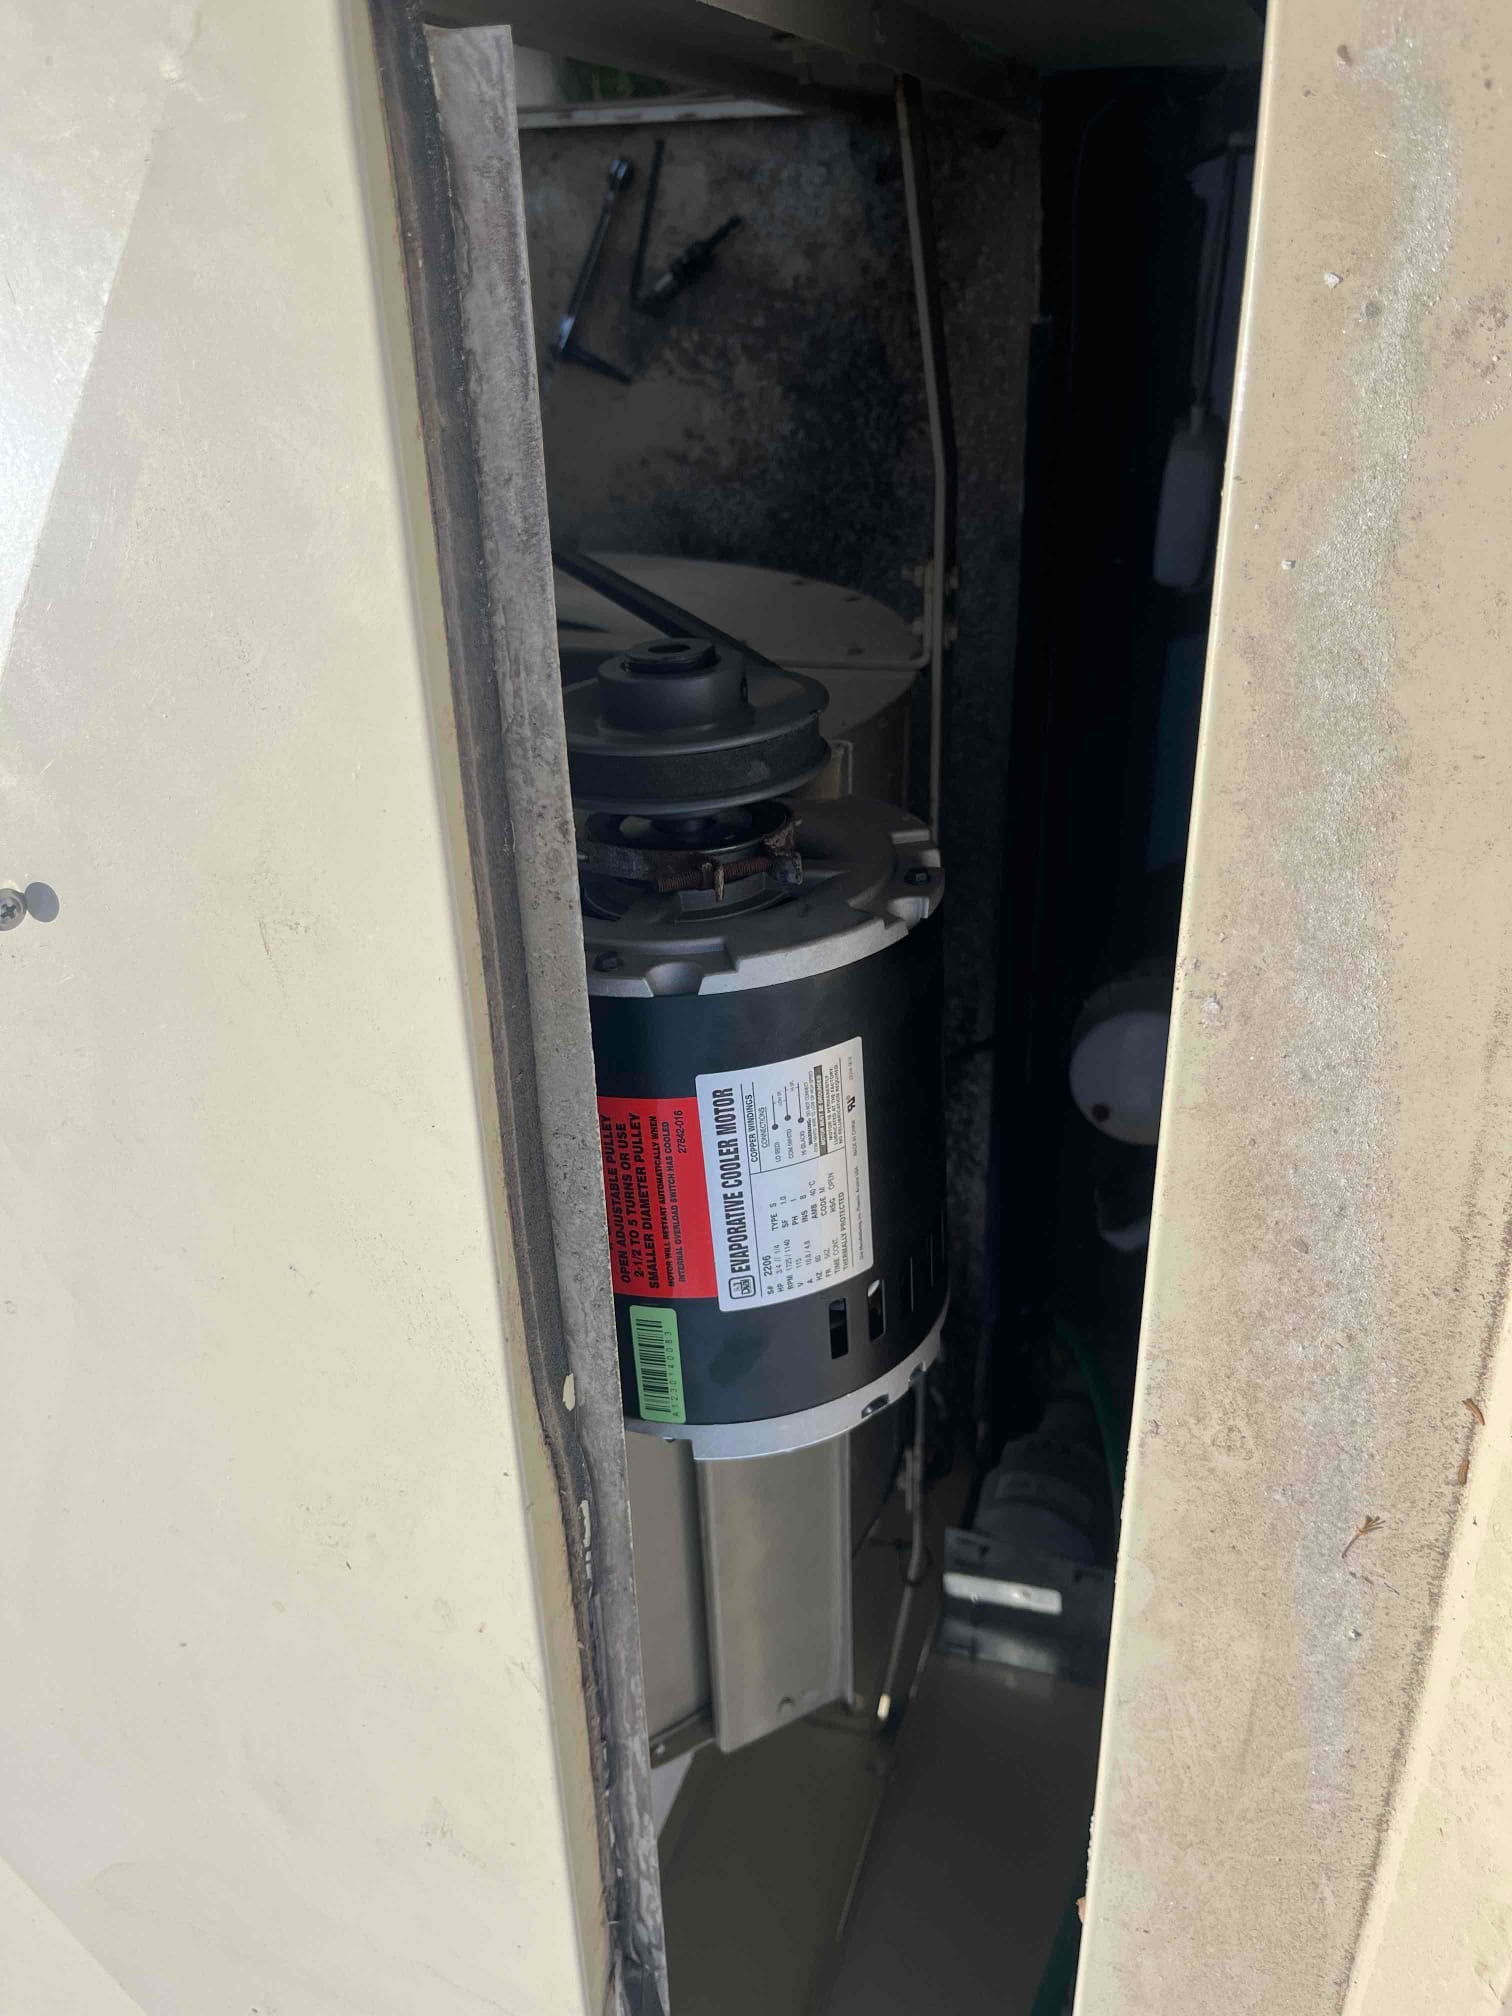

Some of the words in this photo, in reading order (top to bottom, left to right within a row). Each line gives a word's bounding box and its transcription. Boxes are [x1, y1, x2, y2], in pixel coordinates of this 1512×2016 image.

[712, 1088, 736, 1136] MOTOR
[745, 1094, 755, 1131] WINDINGS
[599, 1115, 616, 1163] PULLEY
[616, 1124, 628, 1148] USE
[629, 1113, 644, 1162] PULLEY
[648, 1116, 658, 1139] WHEN
[662, 1122, 672, 1153] COOLED
[758, 1107, 768, 1148] CONNECTIONS
[620, 1153, 631, 1170] OR
[749, 1134, 758, 1162] COPPER
[652, 1142, 665, 1204] AUTOMATICALLY
[666, 1156, 674, 1172] HAS
[718, 1139, 742, 1188] COOLER
[622, 1174, 636, 1215] TURNS
[636, 1167, 652, 1230] DIAMETER
[668, 1174, 677, 1202] SWITCH
[608, 1168, 626, 1248] ADJUSTABLE
[770, 1213, 778, 1231] TYPE
[792, 1216, 798, 1225] PH
[810, 1204, 818, 1218] AMB
[838, 1192, 846, 1231] PROTECTED
[629, 1230, 640, 1245] TO
[660, 1207, 669, 1239] RESTART
[671, 1205, 682, 1244] OVERLOAD
[723, 1191, 750, 1273] EVAPORATIVE
[782, 1220, 788, 1228] SF
[632, 1250, 644, 1277] 2-1/2
[644, 1234, 659, 1288] SMALLER
[664, 1242, 672, 1259] WILL
[676, 1248, 686, 1282] INTERNAL
[840, 1234, 848, 1270] THERMALLY
[618, 1251, 631, 1283] OPEN
[666, 1262, 674, 1286] MOTOR
[762, 1256, 772, 1276] 2206
[816, 1272, 822, 1281] HZ
[825, 1269, 831, 1277] FR
[777, 1283, 784, 1292] HP
[786, 1275, 794, 1289] RPM
